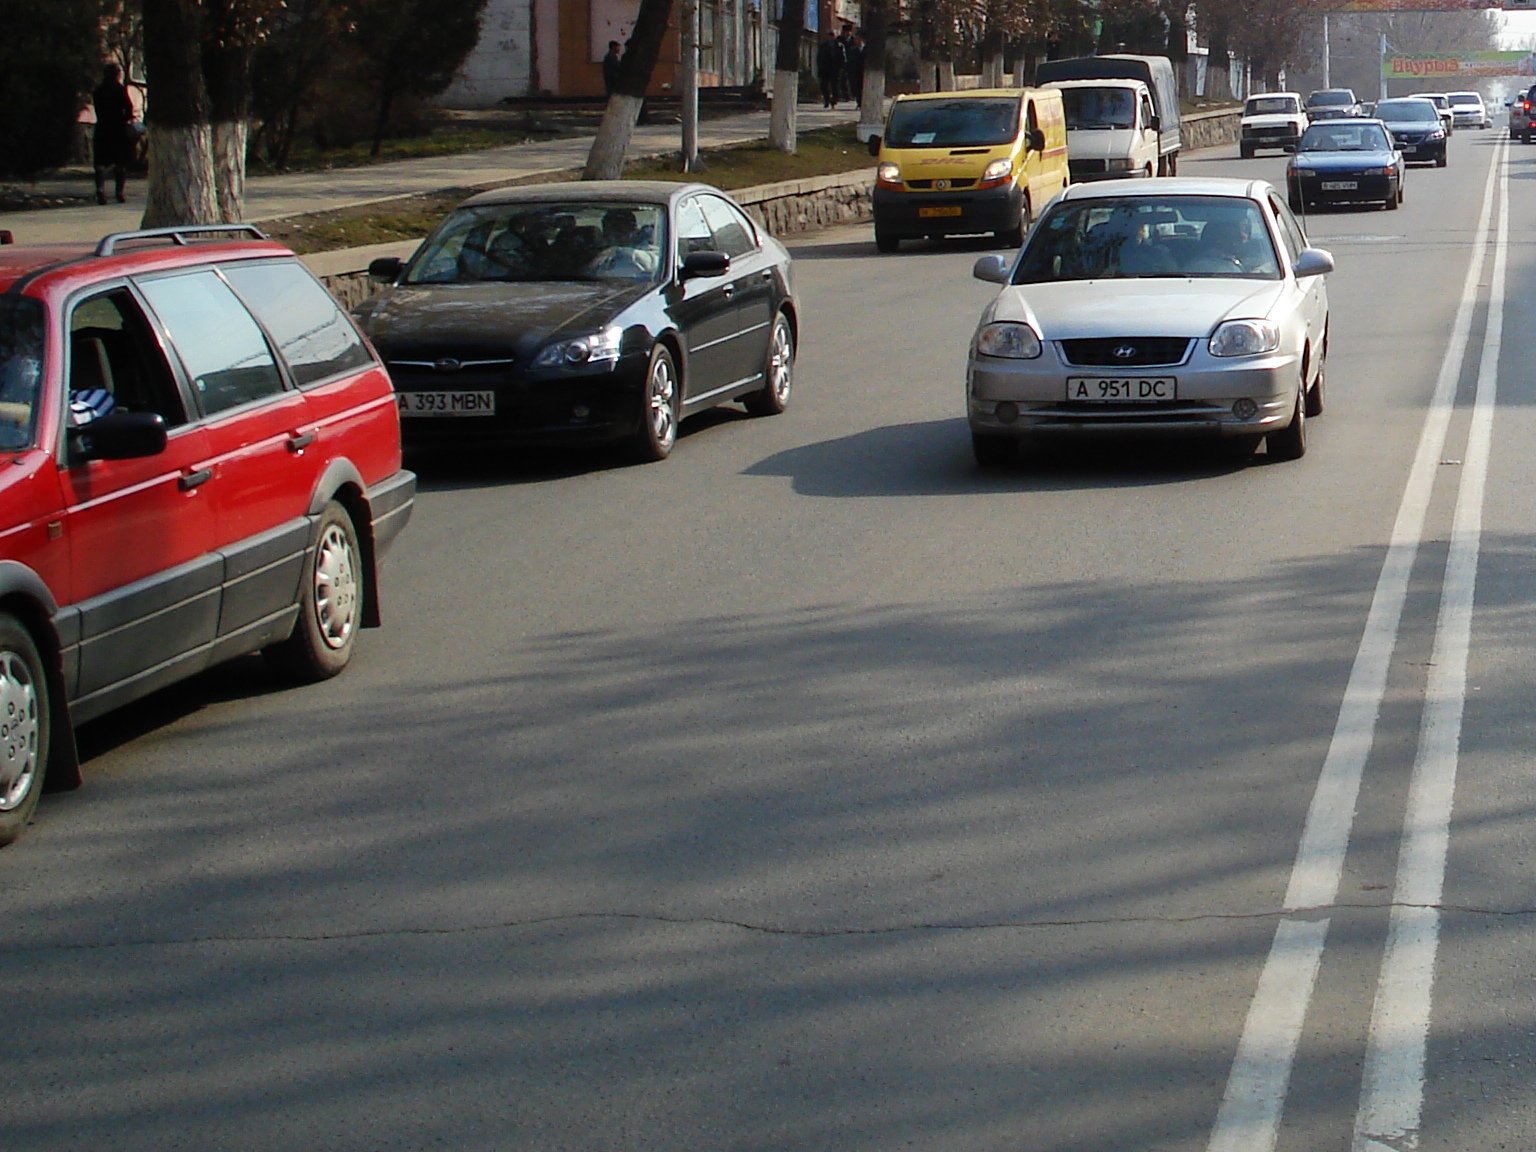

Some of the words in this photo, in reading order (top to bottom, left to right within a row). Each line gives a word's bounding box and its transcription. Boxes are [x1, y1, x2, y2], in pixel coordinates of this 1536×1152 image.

[1076, 380, 1089, 398] A
[1098, 380, 1130, 398] 951
[1139, 380, 1166, 398] DC
[398, 394, 409, 409] A
[415, 393, 446, 410] 393
[451, 393, 491, 409] MBN
